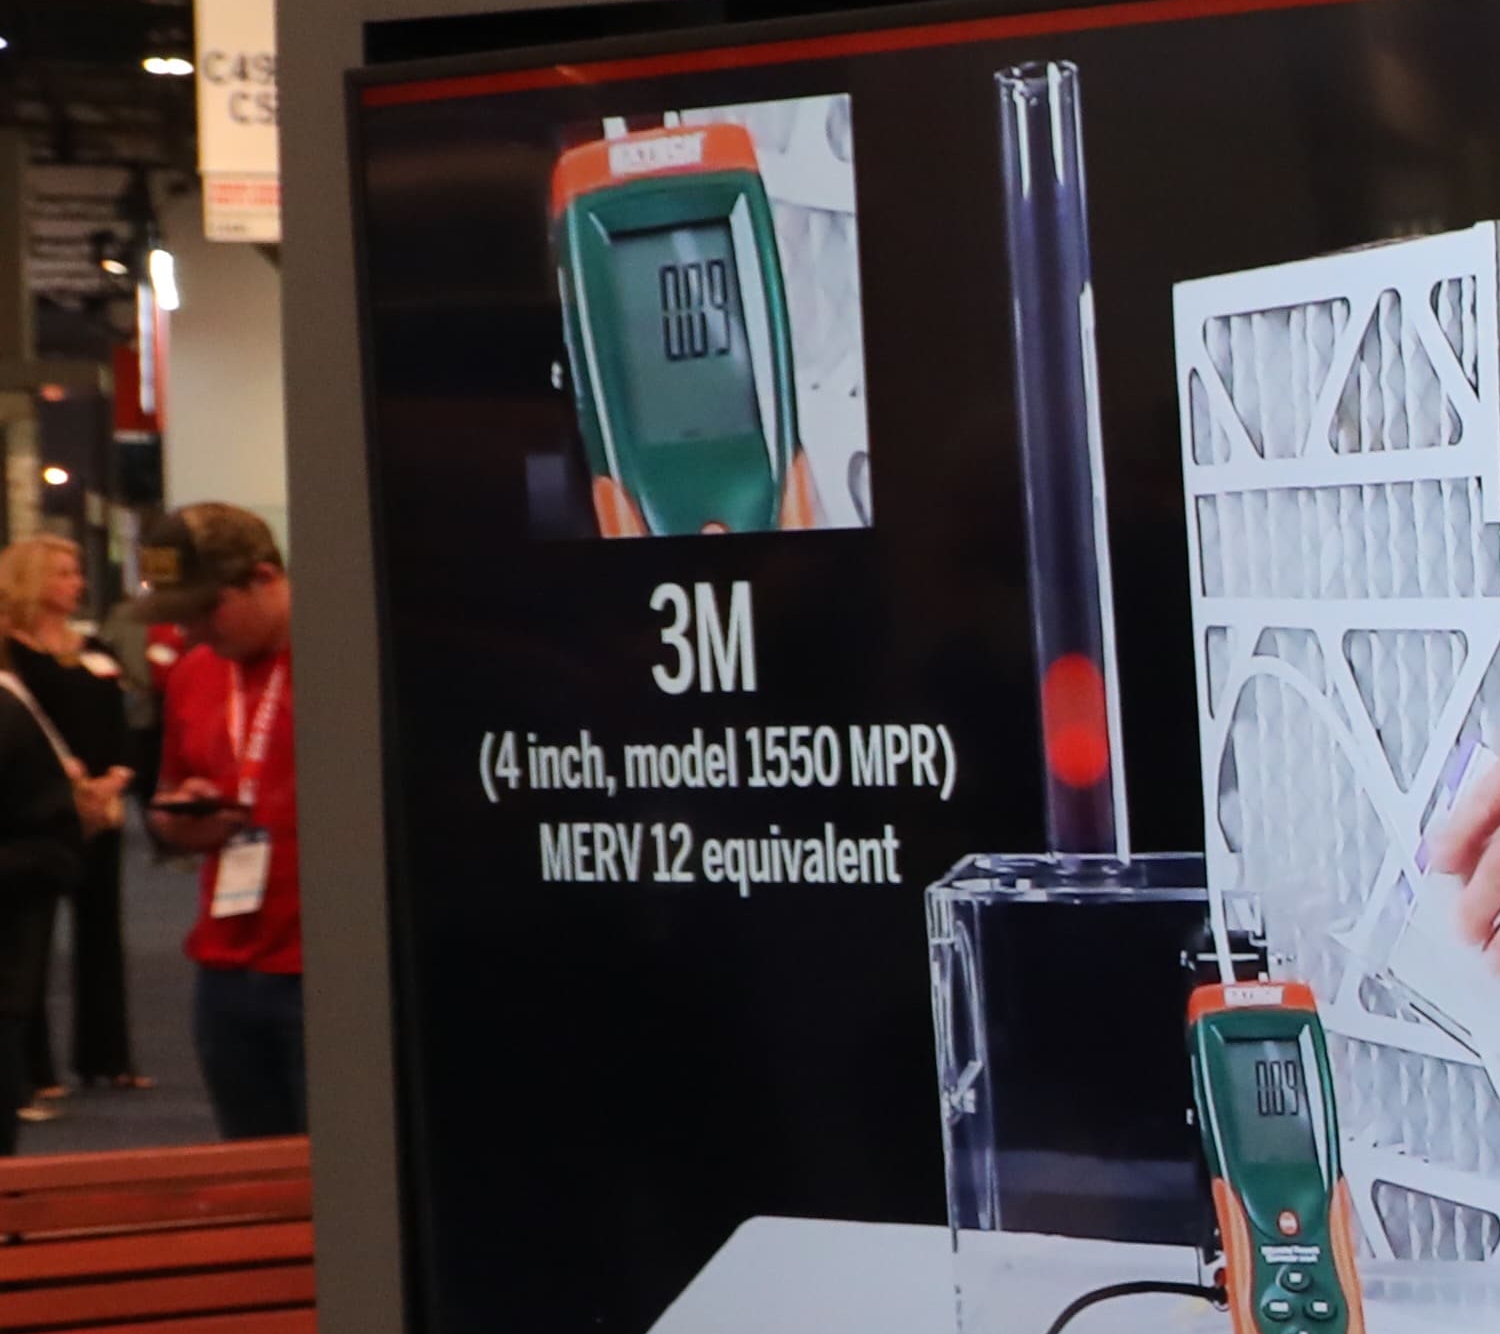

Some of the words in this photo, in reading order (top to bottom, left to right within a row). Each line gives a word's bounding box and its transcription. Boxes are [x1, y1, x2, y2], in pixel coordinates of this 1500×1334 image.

[649, 580, 758, 695] 3M
[479, 730, 521, 802] (4
[527, 729, 615, 798] inch,
[624, 727, 739, 790] model
[746, 727, 840, 788] 1550
[850, 724, 958, 800] MPR)
[540, 822, 643, 882] MERV
[651, 822, 695, 882] 12
[702, 822, 902, 897] equivalent
